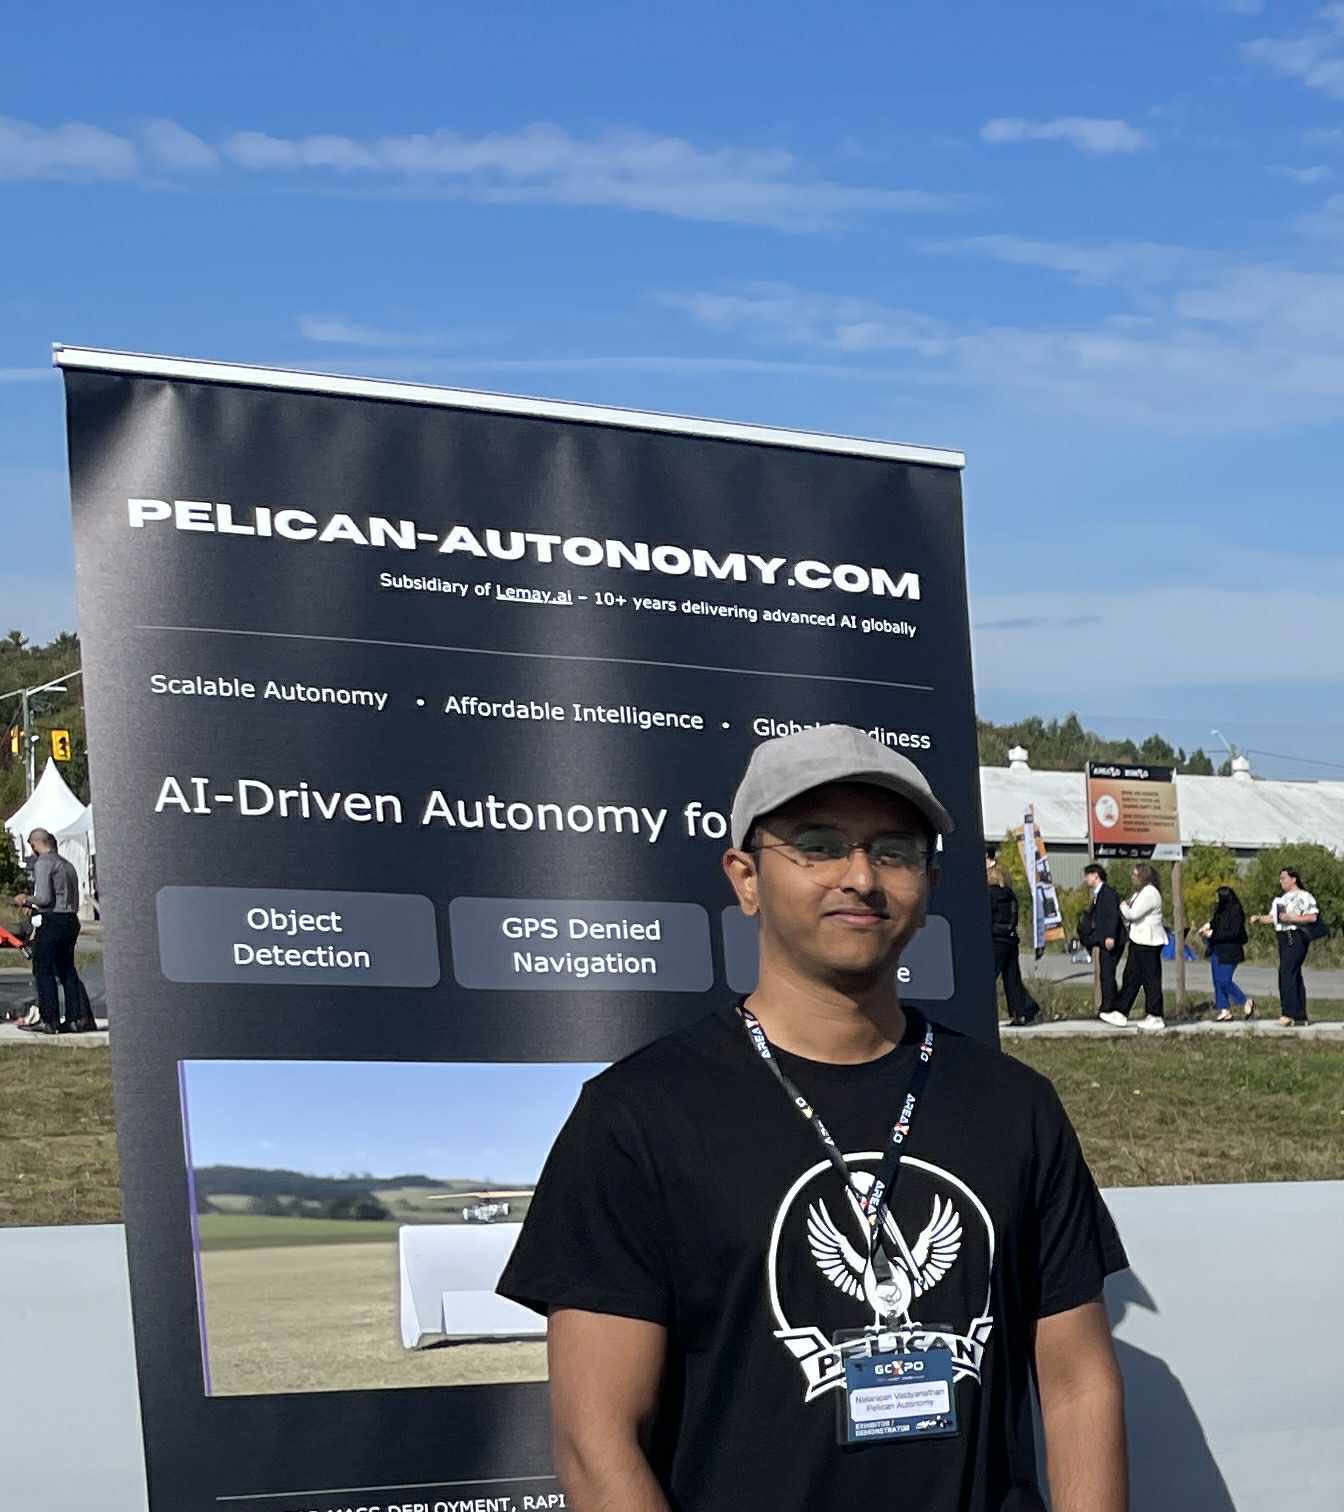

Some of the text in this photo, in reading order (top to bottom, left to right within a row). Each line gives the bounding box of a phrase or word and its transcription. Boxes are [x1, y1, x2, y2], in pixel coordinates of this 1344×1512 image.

[127, 498, 921, 600] PELICAN-AUTONOMY.COM
[380, 572, 468, 597] Subsidiary
[474, 582, 491, 597] of
[496, 583, 573, 606] Lemay.ai
[595, 591, 627, 607] 10+
[633, 595, 677, 615] years
[682, 601, 758, 623] delivering
[762, 608, 836, 627] advanced
[840, 614, 858, 629] AI
[862, 617, 917, 638] globally
[150, 674, 256, 698] Scalable
[264, 680, 388, 711] Autonomy
[445, 695, 565, 721] Affordable
[573, 703, 704, 729] Intelligence
[154, 776, 729, 843] AI-Driven Autonomy fo
[246, 907, 342, 937] Object
[503, 916, 662, 942] GPS Denied
[232, 941, 371, 969] Detection
[513, 949, 657, 979] Navigation
[523, 1494, 566, 1511] RAPI
